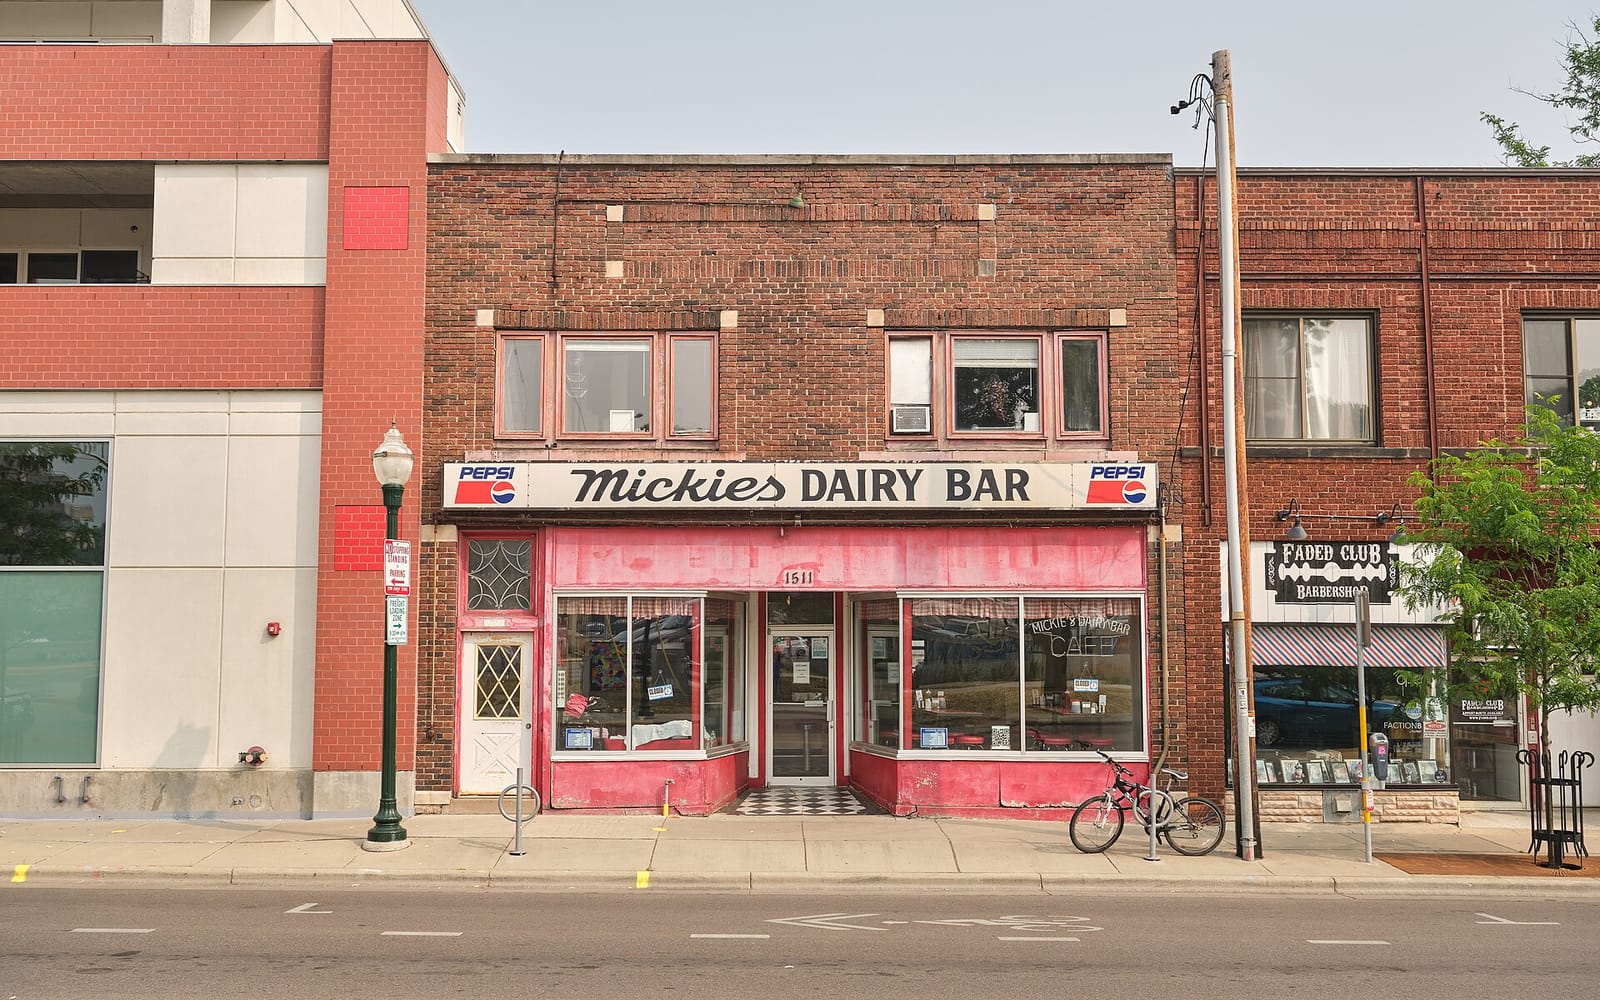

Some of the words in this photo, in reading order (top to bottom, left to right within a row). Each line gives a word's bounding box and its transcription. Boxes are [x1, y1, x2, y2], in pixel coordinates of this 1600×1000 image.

[459, 466, 515, 480] PEPSI
[1090, 466, 1146, 479] PEPSI
[570, 468, 786, 502] Mickies
[801, 468, 924, 502] DAIRY
[946, 468, 1031, 502] BAR
[386, 543, 392, 554] NO
[392, 546, 409, 555] STOPPING
[1282, 543, 1334, 564] FADED
[1340, 543, 1381, 564] CLUB
[387, 555, 408, 564] STANDING
[389, 569, 405, 578] PARKING
[785, 571, 812, 585] 1511
[390, 599, 405, 607] FREIGHT
[390, 607, 405, 615] LOADING
[1031, 614, 1076, 634] MICKIE'S
[1078, 615, 1108, 629] DAIRY
[1110, 620, 1131, 635] BAR
[1486, 699, 1504, 710] CLUB
